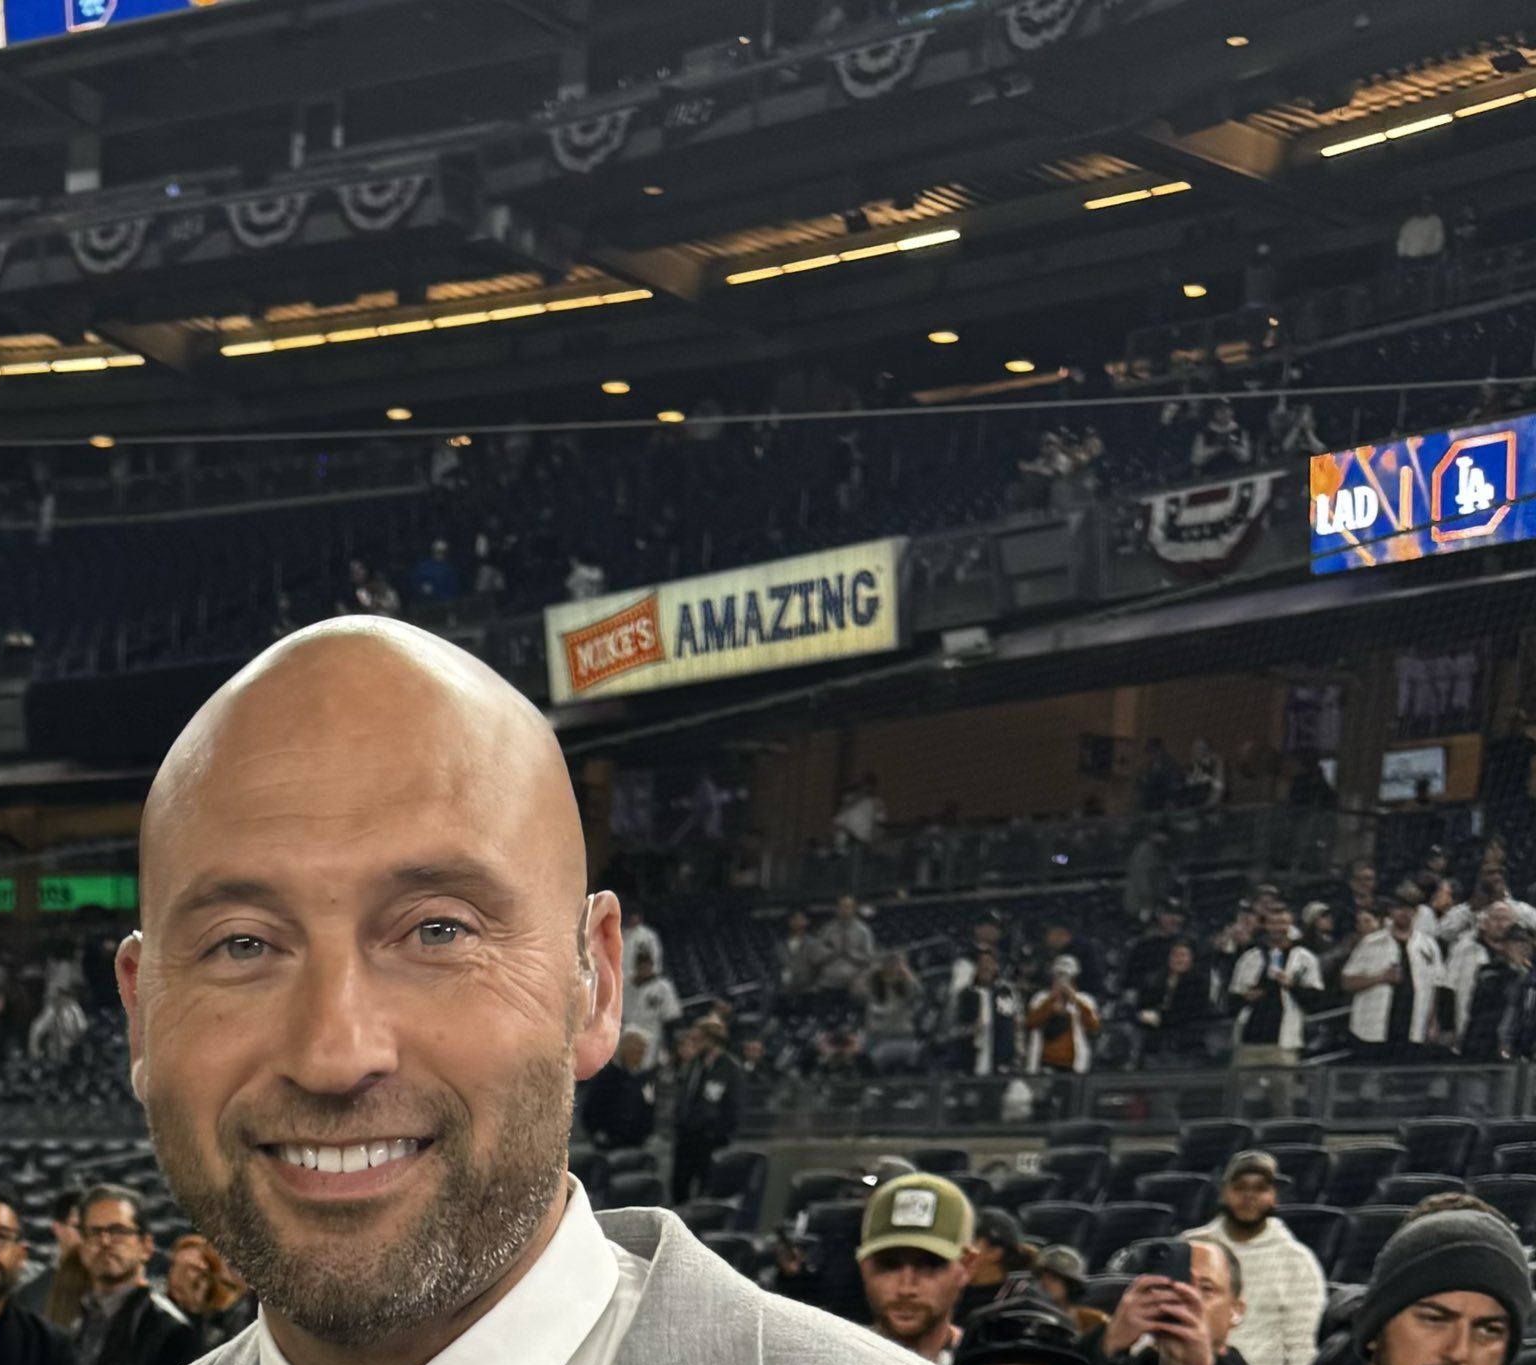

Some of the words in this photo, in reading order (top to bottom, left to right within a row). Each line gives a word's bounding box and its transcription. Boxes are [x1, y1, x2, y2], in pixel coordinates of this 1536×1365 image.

[1315, 486, 1379, 535] LAD
[1455, 456, 1495, 514] LA
[674, 569, 880, 659] AMAZING
